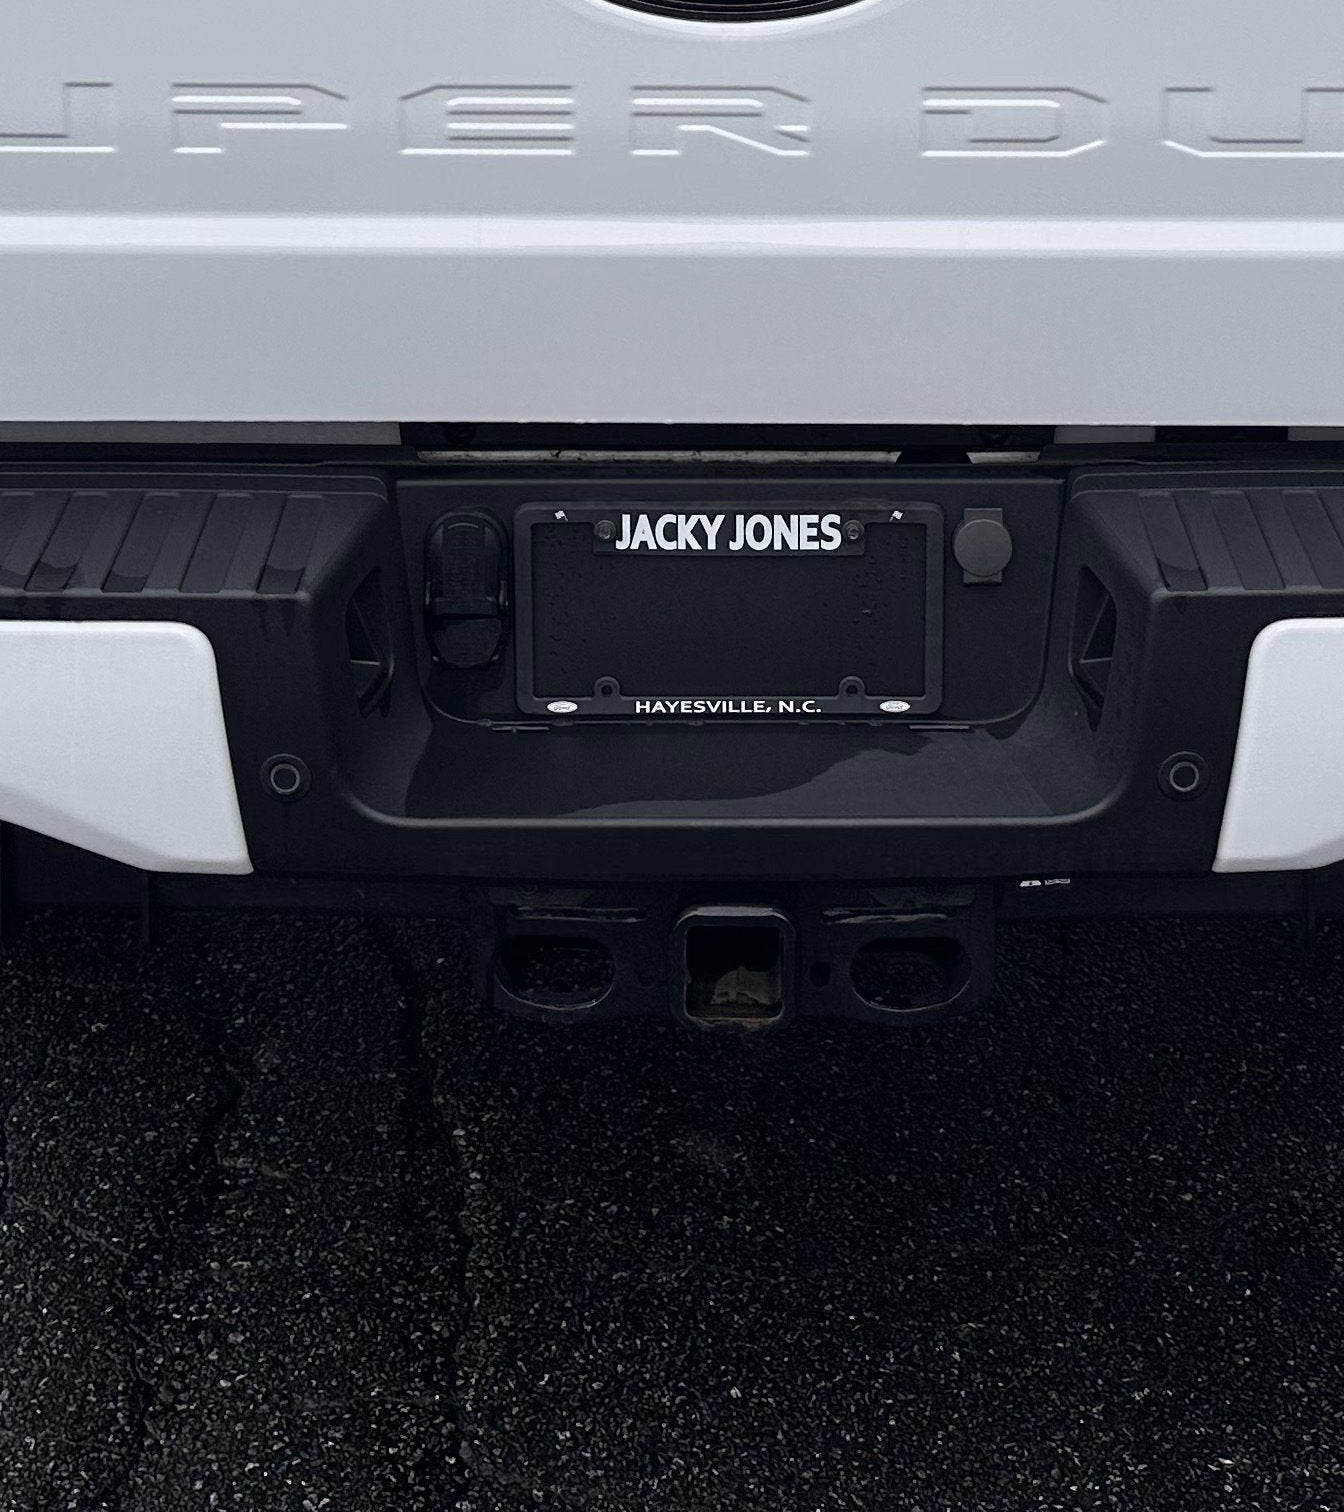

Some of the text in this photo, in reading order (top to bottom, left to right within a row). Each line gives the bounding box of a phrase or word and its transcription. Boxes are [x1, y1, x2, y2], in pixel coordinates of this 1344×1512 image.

[615, 513, 842, 551] JACKY JONES
[634, 699, 822, 714] HAYESVILLE, N.C.
